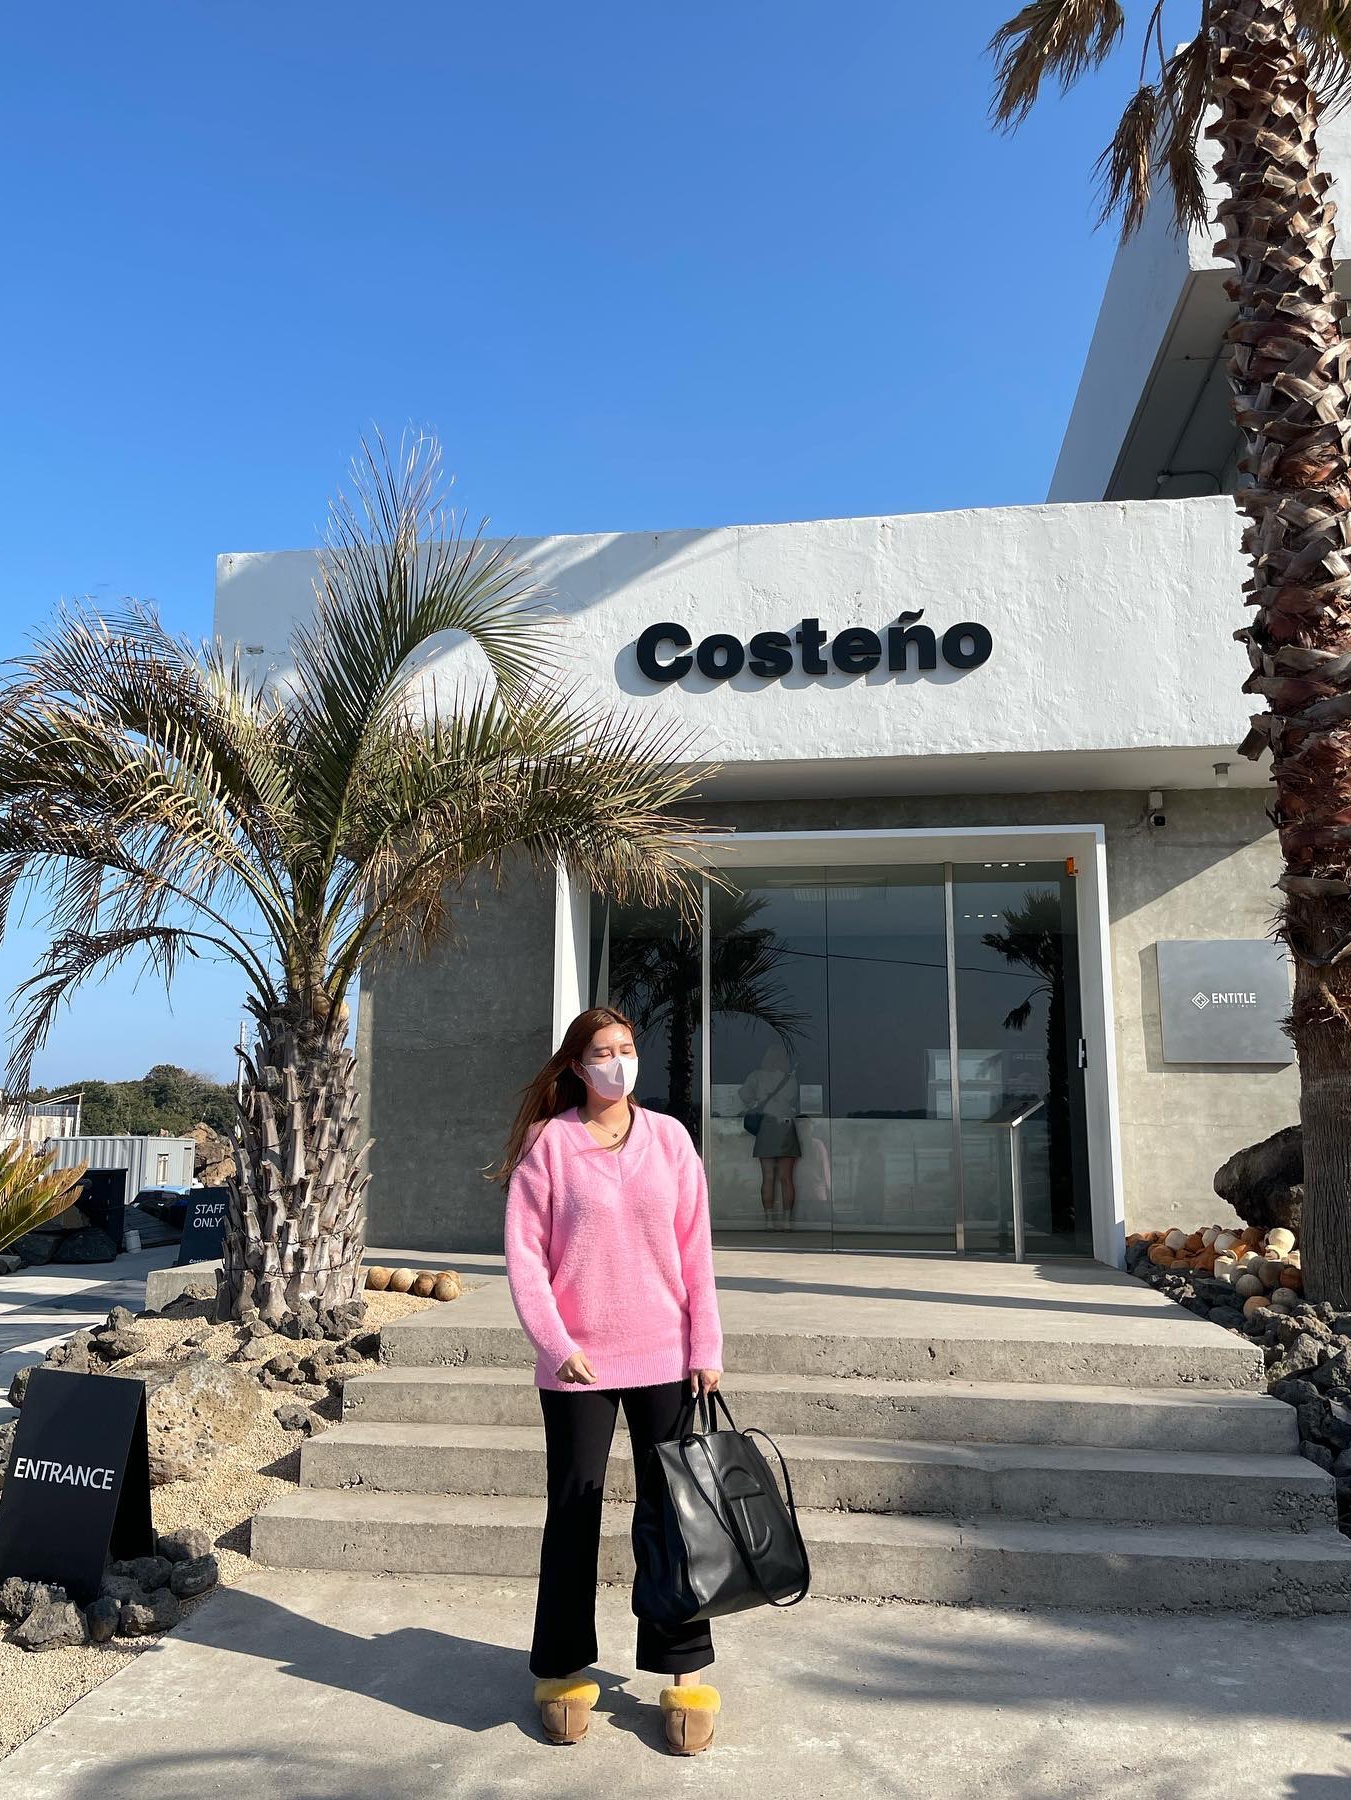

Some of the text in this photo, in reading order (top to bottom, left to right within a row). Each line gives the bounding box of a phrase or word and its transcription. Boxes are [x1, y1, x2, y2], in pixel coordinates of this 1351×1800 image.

[636, 608, 993, 682] Costeño
[1211, 992, 1257, 1004] ENTITLE
[194, 1203, 225, 1215] STAFF
[193, 1217, 222, 1228] ONLY
[13, 1457, 115, 1491] ENTRANCE
